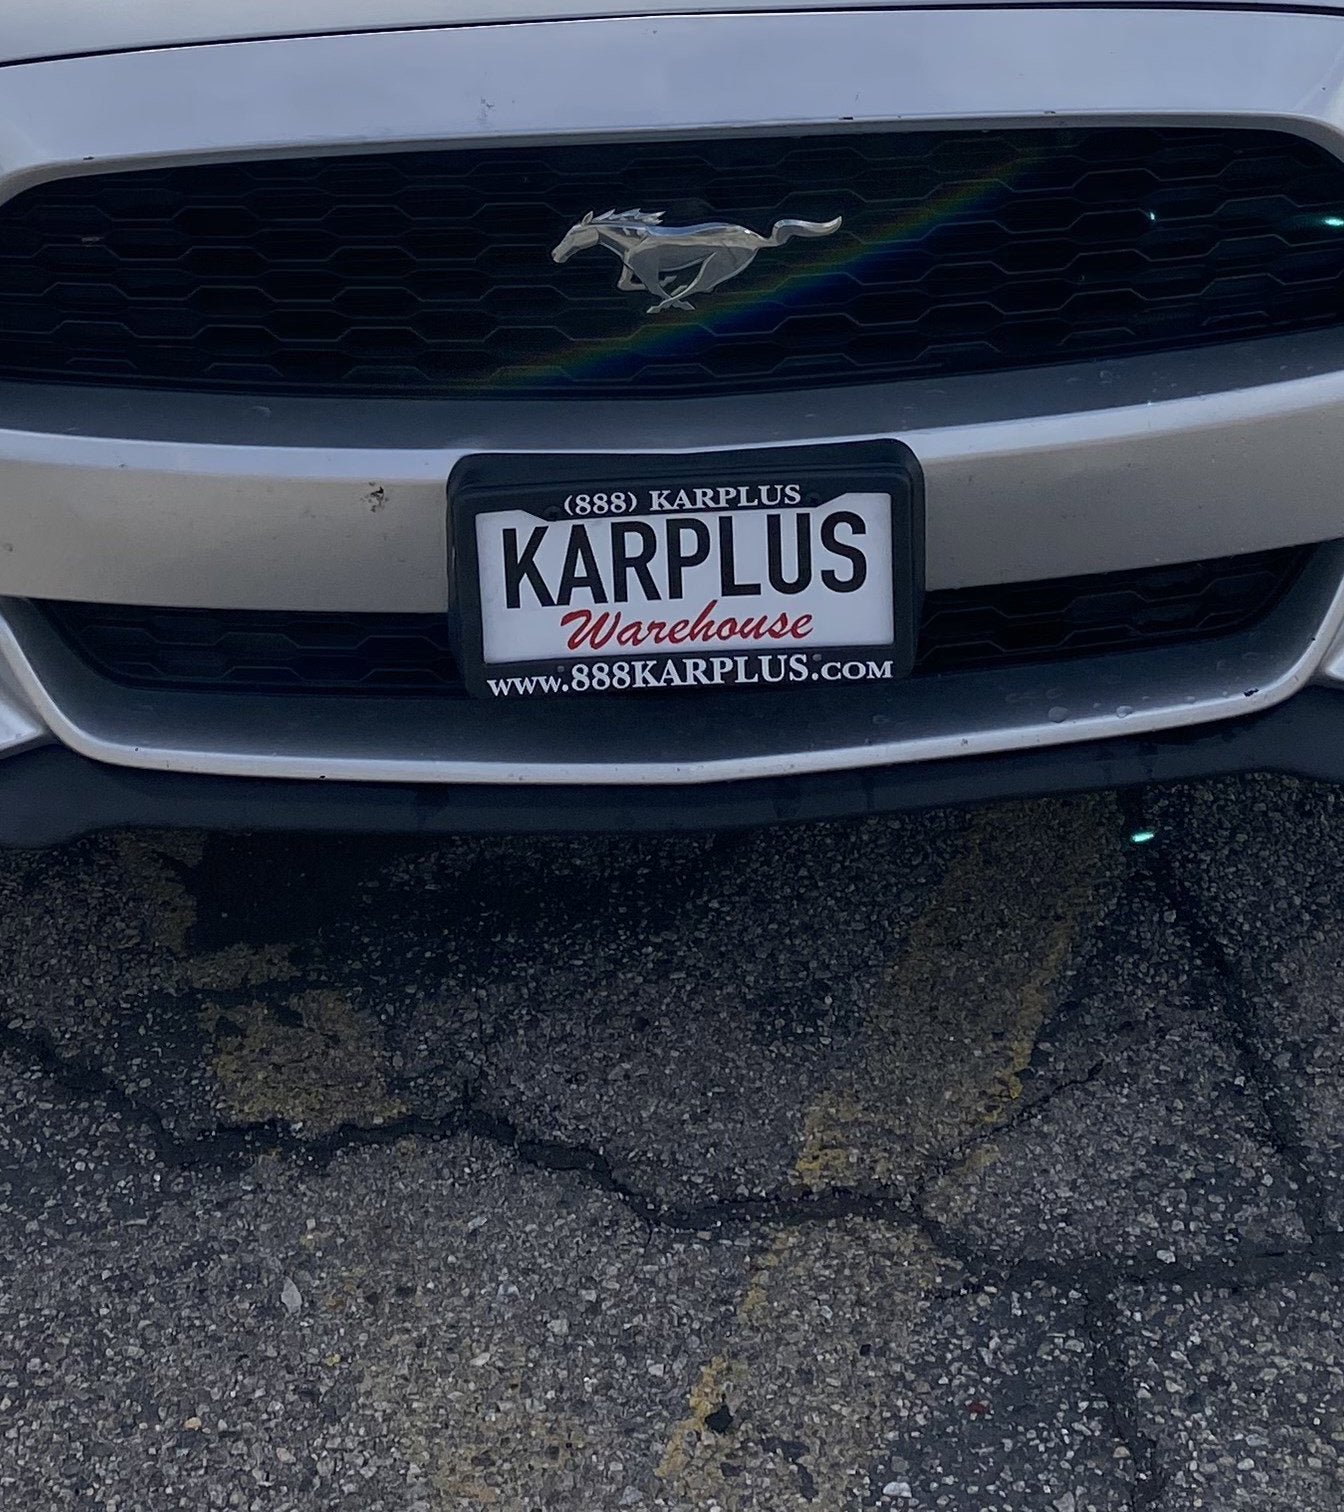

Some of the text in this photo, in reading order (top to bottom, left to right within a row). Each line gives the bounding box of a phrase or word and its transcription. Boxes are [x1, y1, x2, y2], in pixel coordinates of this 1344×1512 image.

[563, 484, 801, 516] (888) KARPLUS
[502, 511, 867, 609] KARPLUS
[560, 600, 813, 650] Warehouse
